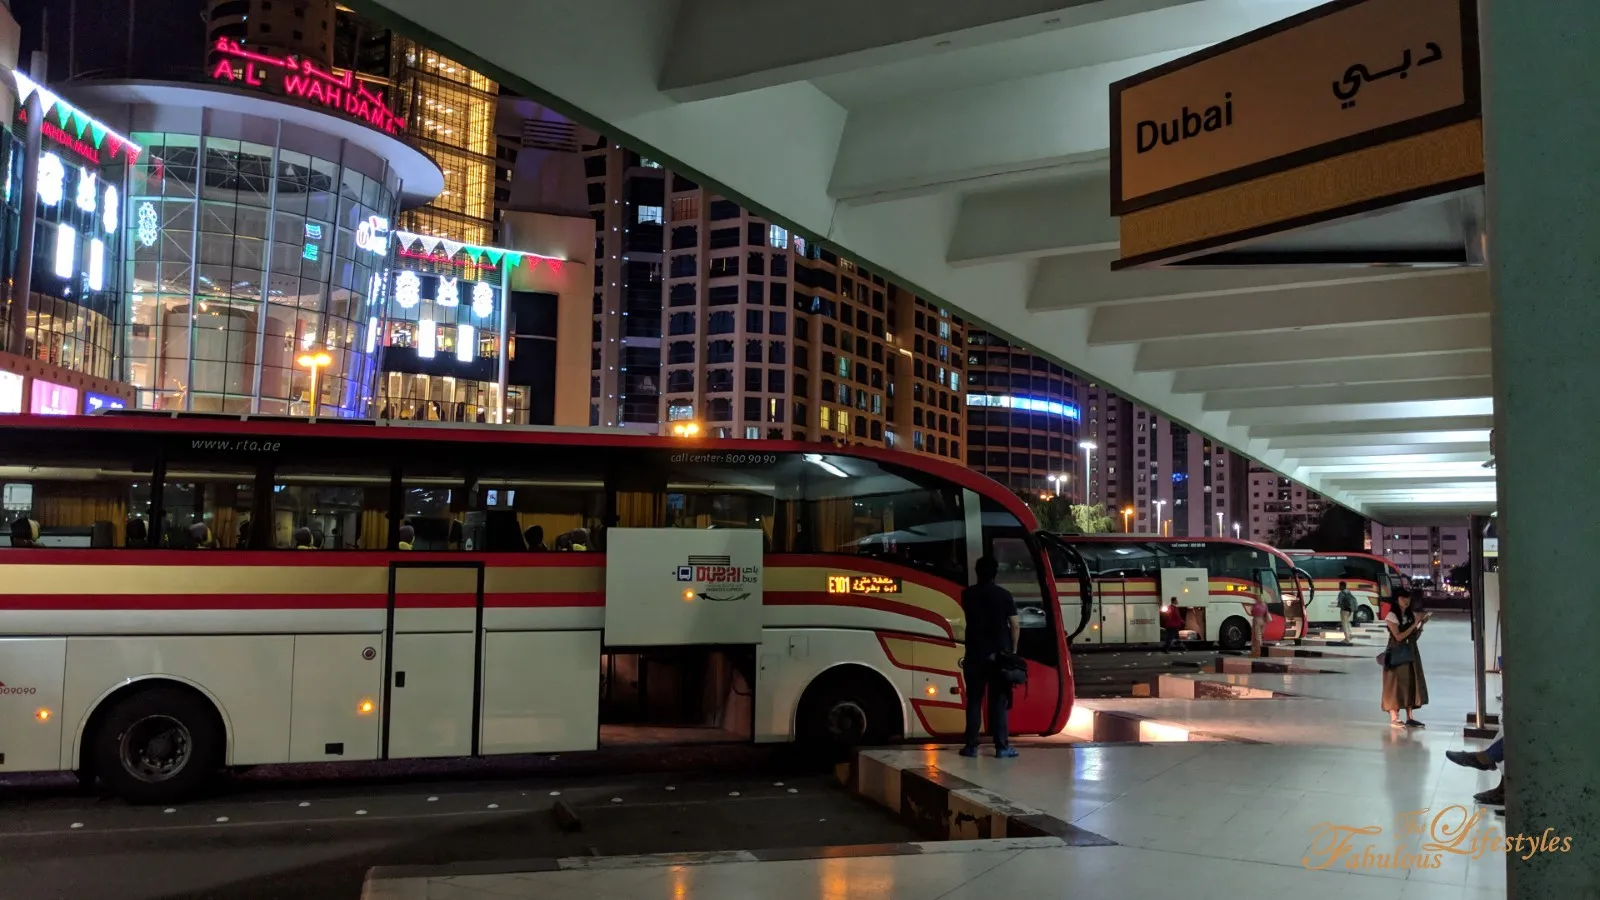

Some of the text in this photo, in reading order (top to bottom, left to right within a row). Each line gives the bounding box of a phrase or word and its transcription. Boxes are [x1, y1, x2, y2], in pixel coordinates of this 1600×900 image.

[1332, 41, 1443, 109] دبي
[213, 59, 262, 87] AL
[284, 75, 370, 121] WAHDA
[1136, 92, 1233, 154] Dubai
[191, 439, 281, 452] www.rta.ae
[671, 452, 777, 464] call center: 800 90 90
[696, 566, 741, 584] DUBAI
[742, 575, 758, 583] bus
[828, 576, 850, 593] E101
